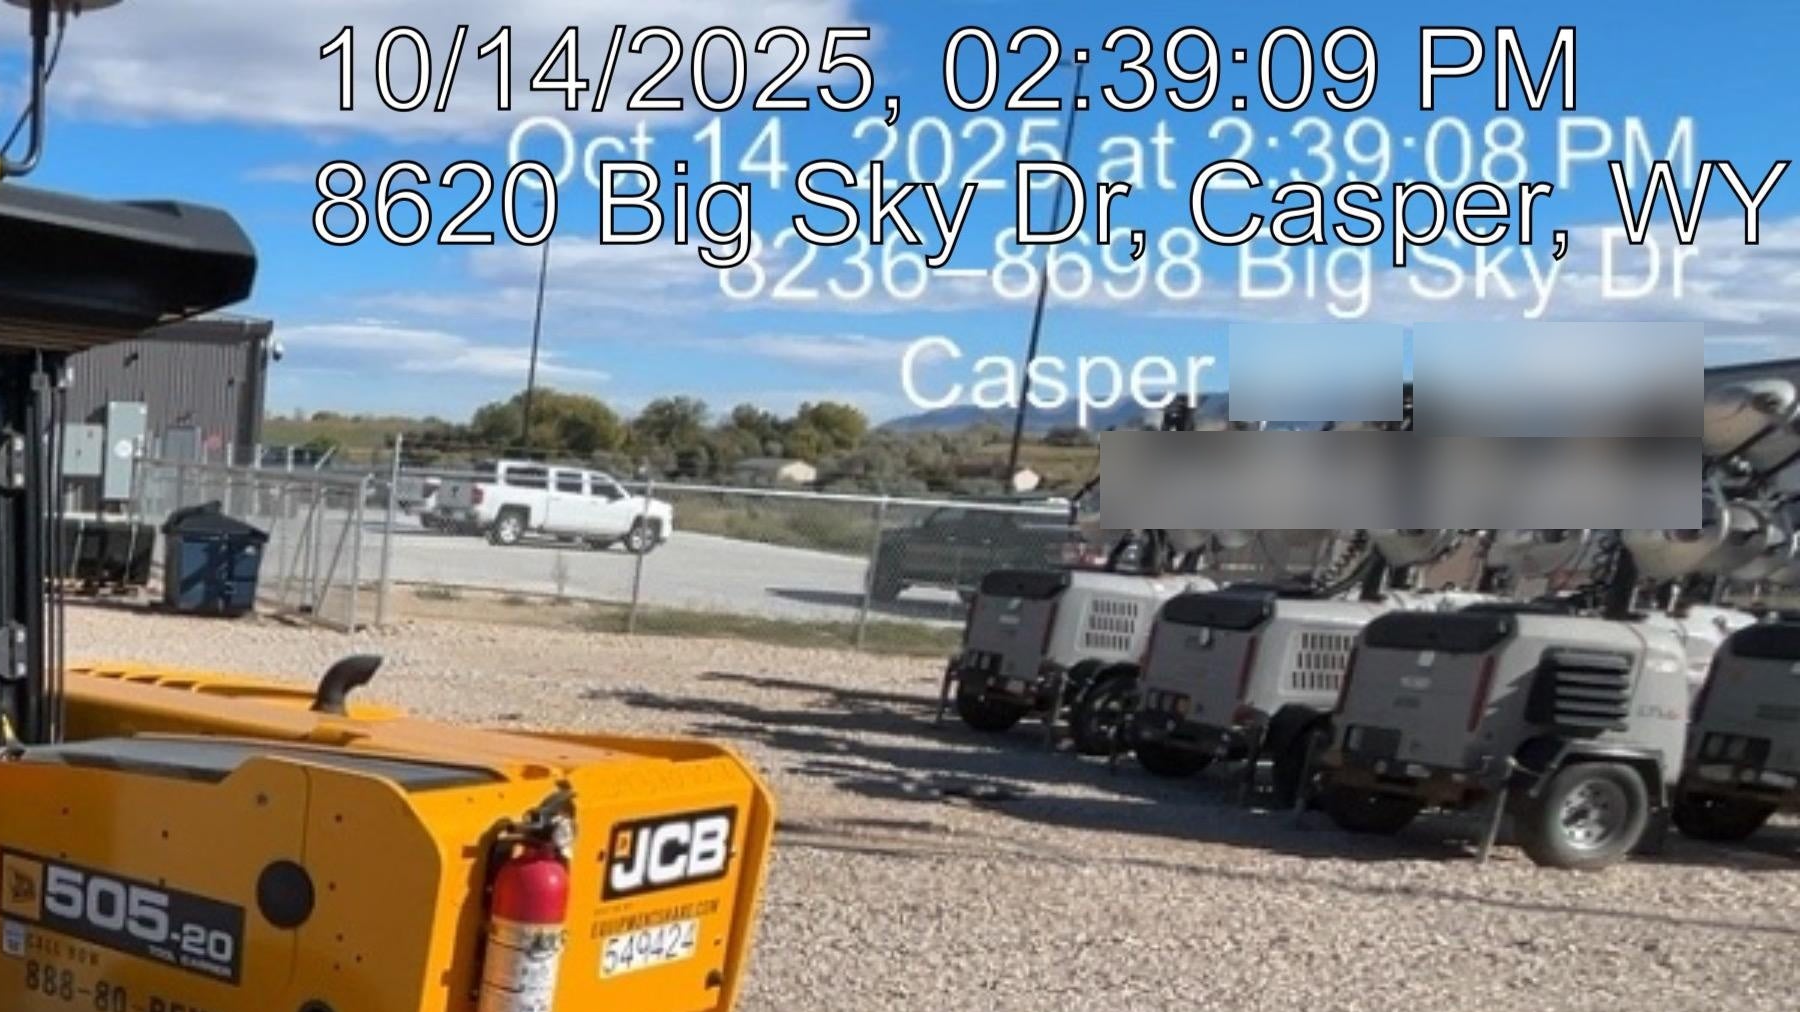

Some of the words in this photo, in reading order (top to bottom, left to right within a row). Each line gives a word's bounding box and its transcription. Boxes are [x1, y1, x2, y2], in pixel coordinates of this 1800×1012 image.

[609, 814, 730, 892] JCB
[45, 863, 235, 964] 505-20
[603, 921, 696, 975] 549424
